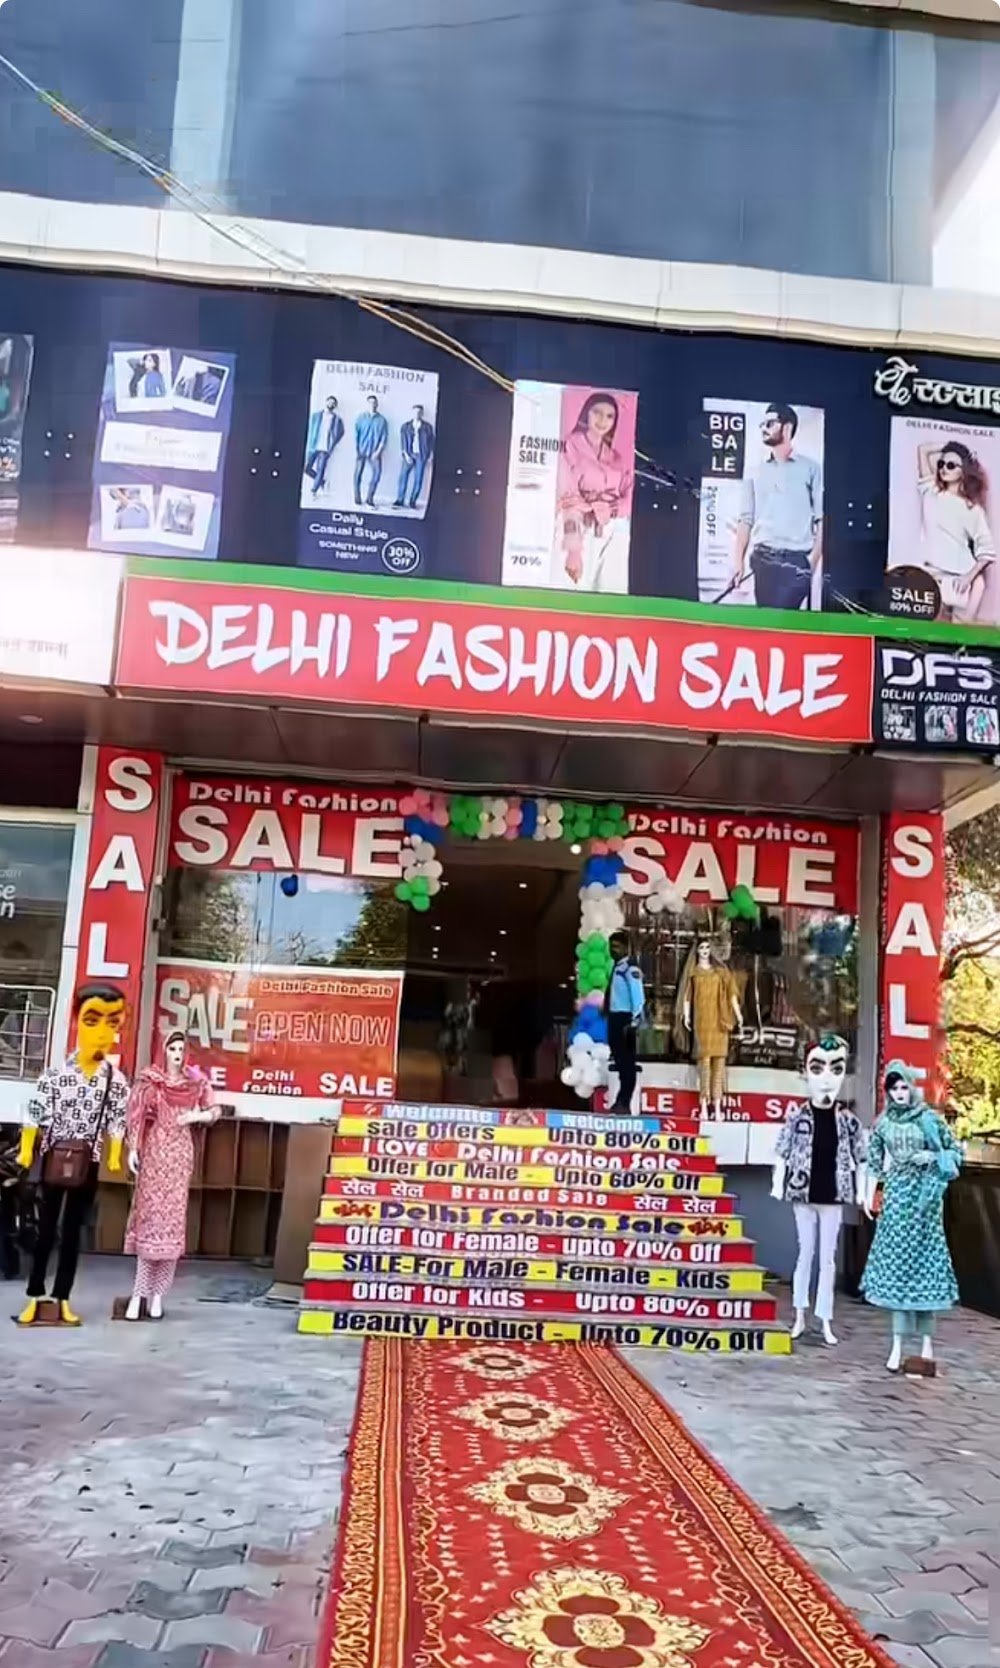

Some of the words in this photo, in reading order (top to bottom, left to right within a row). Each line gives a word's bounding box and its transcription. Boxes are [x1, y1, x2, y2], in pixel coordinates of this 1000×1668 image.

[709, 414, 744, 431] BIG
[520, 435, 567, 453] FASHION
[711, 434, 738, 450] SA
[518, 450, 547, 465] SALE
[711, 456, 737, 472] LE
[331, 512, 364, 526] Daily
[309, 523, 352, 536] Casual
[354, 527, 389, 540] Style
[318, 540, 378, 553] SOMETHING
[510, 555, 542, 567] 70%
[891, 587, 935, 605] SALE
[913, 604, 935, 614] OFF
[148, 600, 351, 679] DELHI
[374, 615, 657, 704] FASHION
[679, 641, 849, 718] SALE
[881, 648, 992, 690] DFS
[881, 688, 915, 701] DELHI
[918, 690, 967, 704] FASHION
[970, 694, 998, 706] SALE
[189, 782, 272, 804] Delhi
[628, 813, 707, 837] Delhi
[174, 805, 405, 878] SALE
[616, 837, 835, 907] SALE
[86, 757, 152, 1071] SAL
[361, 982, 394, 997] Sale
[159, 978, 255, 1053] SALE
[256, 1011, 324, 1042] OPEN
[329, 1014, 390, 1046] NOW
[252, 1069, 295, 1083] Delhi
[319, 1072, 394, 1097] SALE
[605, 1131, 660, 1150] 80%
[458, 1142, 522, 1163] Delhi
[465, 1163, 519, 1181] Male
[609, 1172, 665, 1189] 60%
[340, 1178, 377, 1195] सेल
[390, 1181, 425, 1198] सेल
[451, 1185, 549, 1202] Branded
[557, 1189, 608, 1206] Sale
[633, 1194, 668, 1211] सेल
[682, 1196, 717, 1214] सेल
[380, 1201, 471, 1223] Delhi
[616, 1214, 685, 1236] Sale
[346, 1226, 404, 1245] Offer
[453, 1232, 539, 1251] Female
[623, 1239, 683, 1261] 70%
[463, 1259, 529, 1278] Male
[556, 1262, 650, 1285] Female
[676, 1270, 731, 1290] Kids
[352, 1282, 416, 1301] Offer
[468, 1289, 526, 1308] Kids
[575, 1292, 636, 1313] Upto
[643, 1296, 710, 1318] 80%
[333, 1312, 429, 1337] Beauty
[438, 1317, 545, 1341] Product
[650, 1326, 721, 1350] 70%
